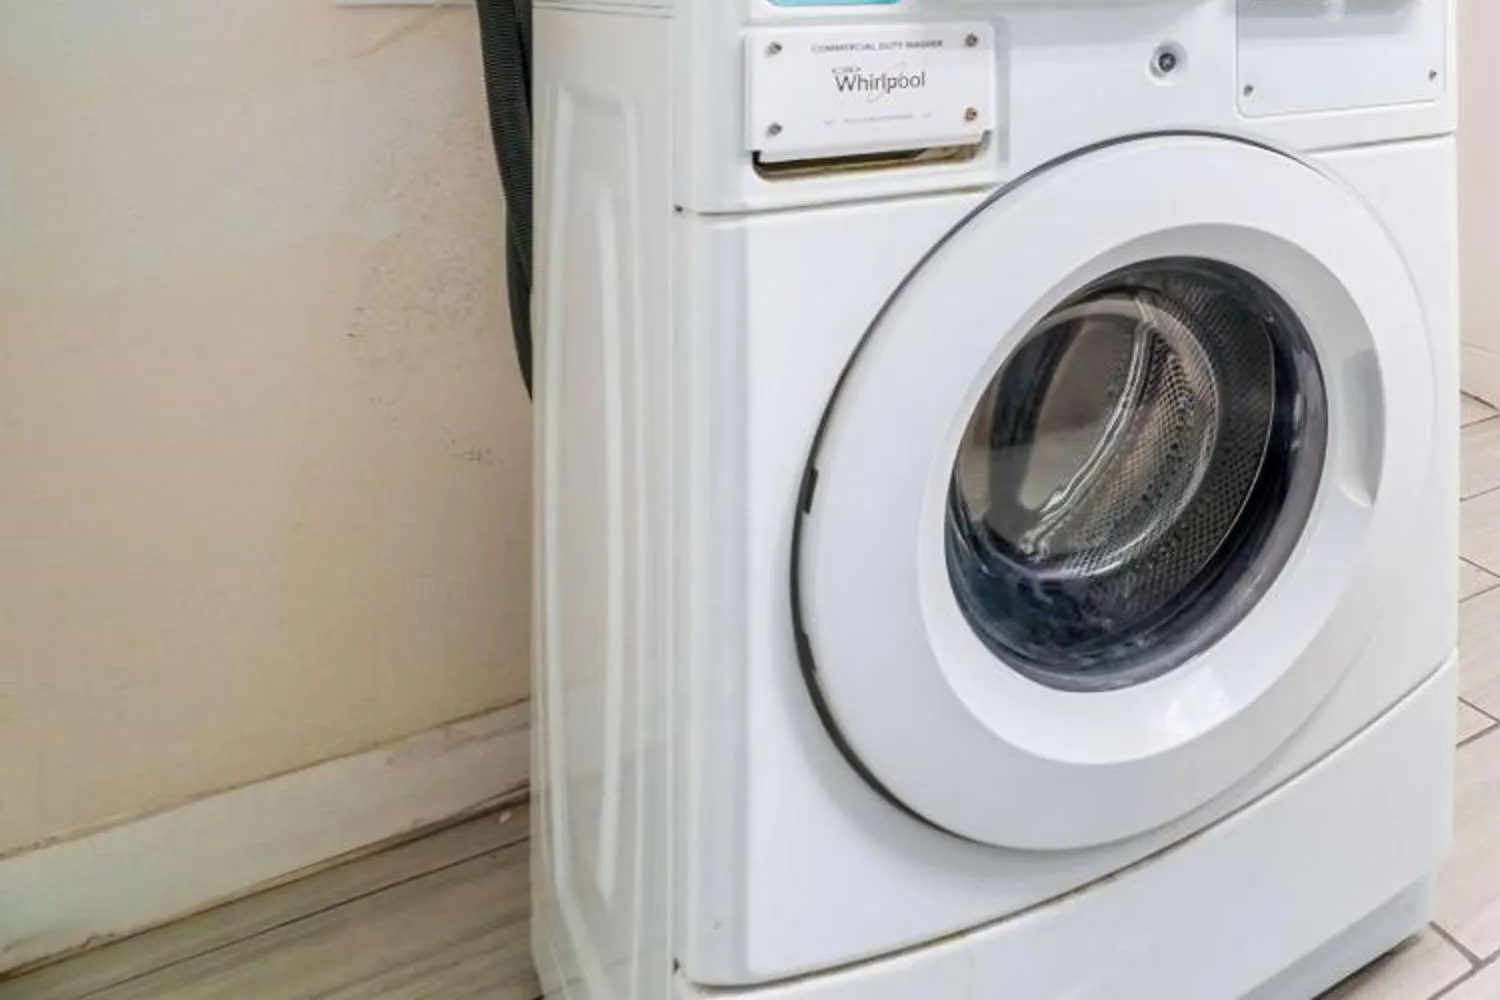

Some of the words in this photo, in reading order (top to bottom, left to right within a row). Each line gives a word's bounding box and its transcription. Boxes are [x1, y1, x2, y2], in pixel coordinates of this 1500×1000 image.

[811, 42, 875, 53] COMMERCIAL
[879, 41, 903, 50] DUTY
[906, 39, 943, 49] WASHER
[835, 71, 926, 93] Whirlpool
